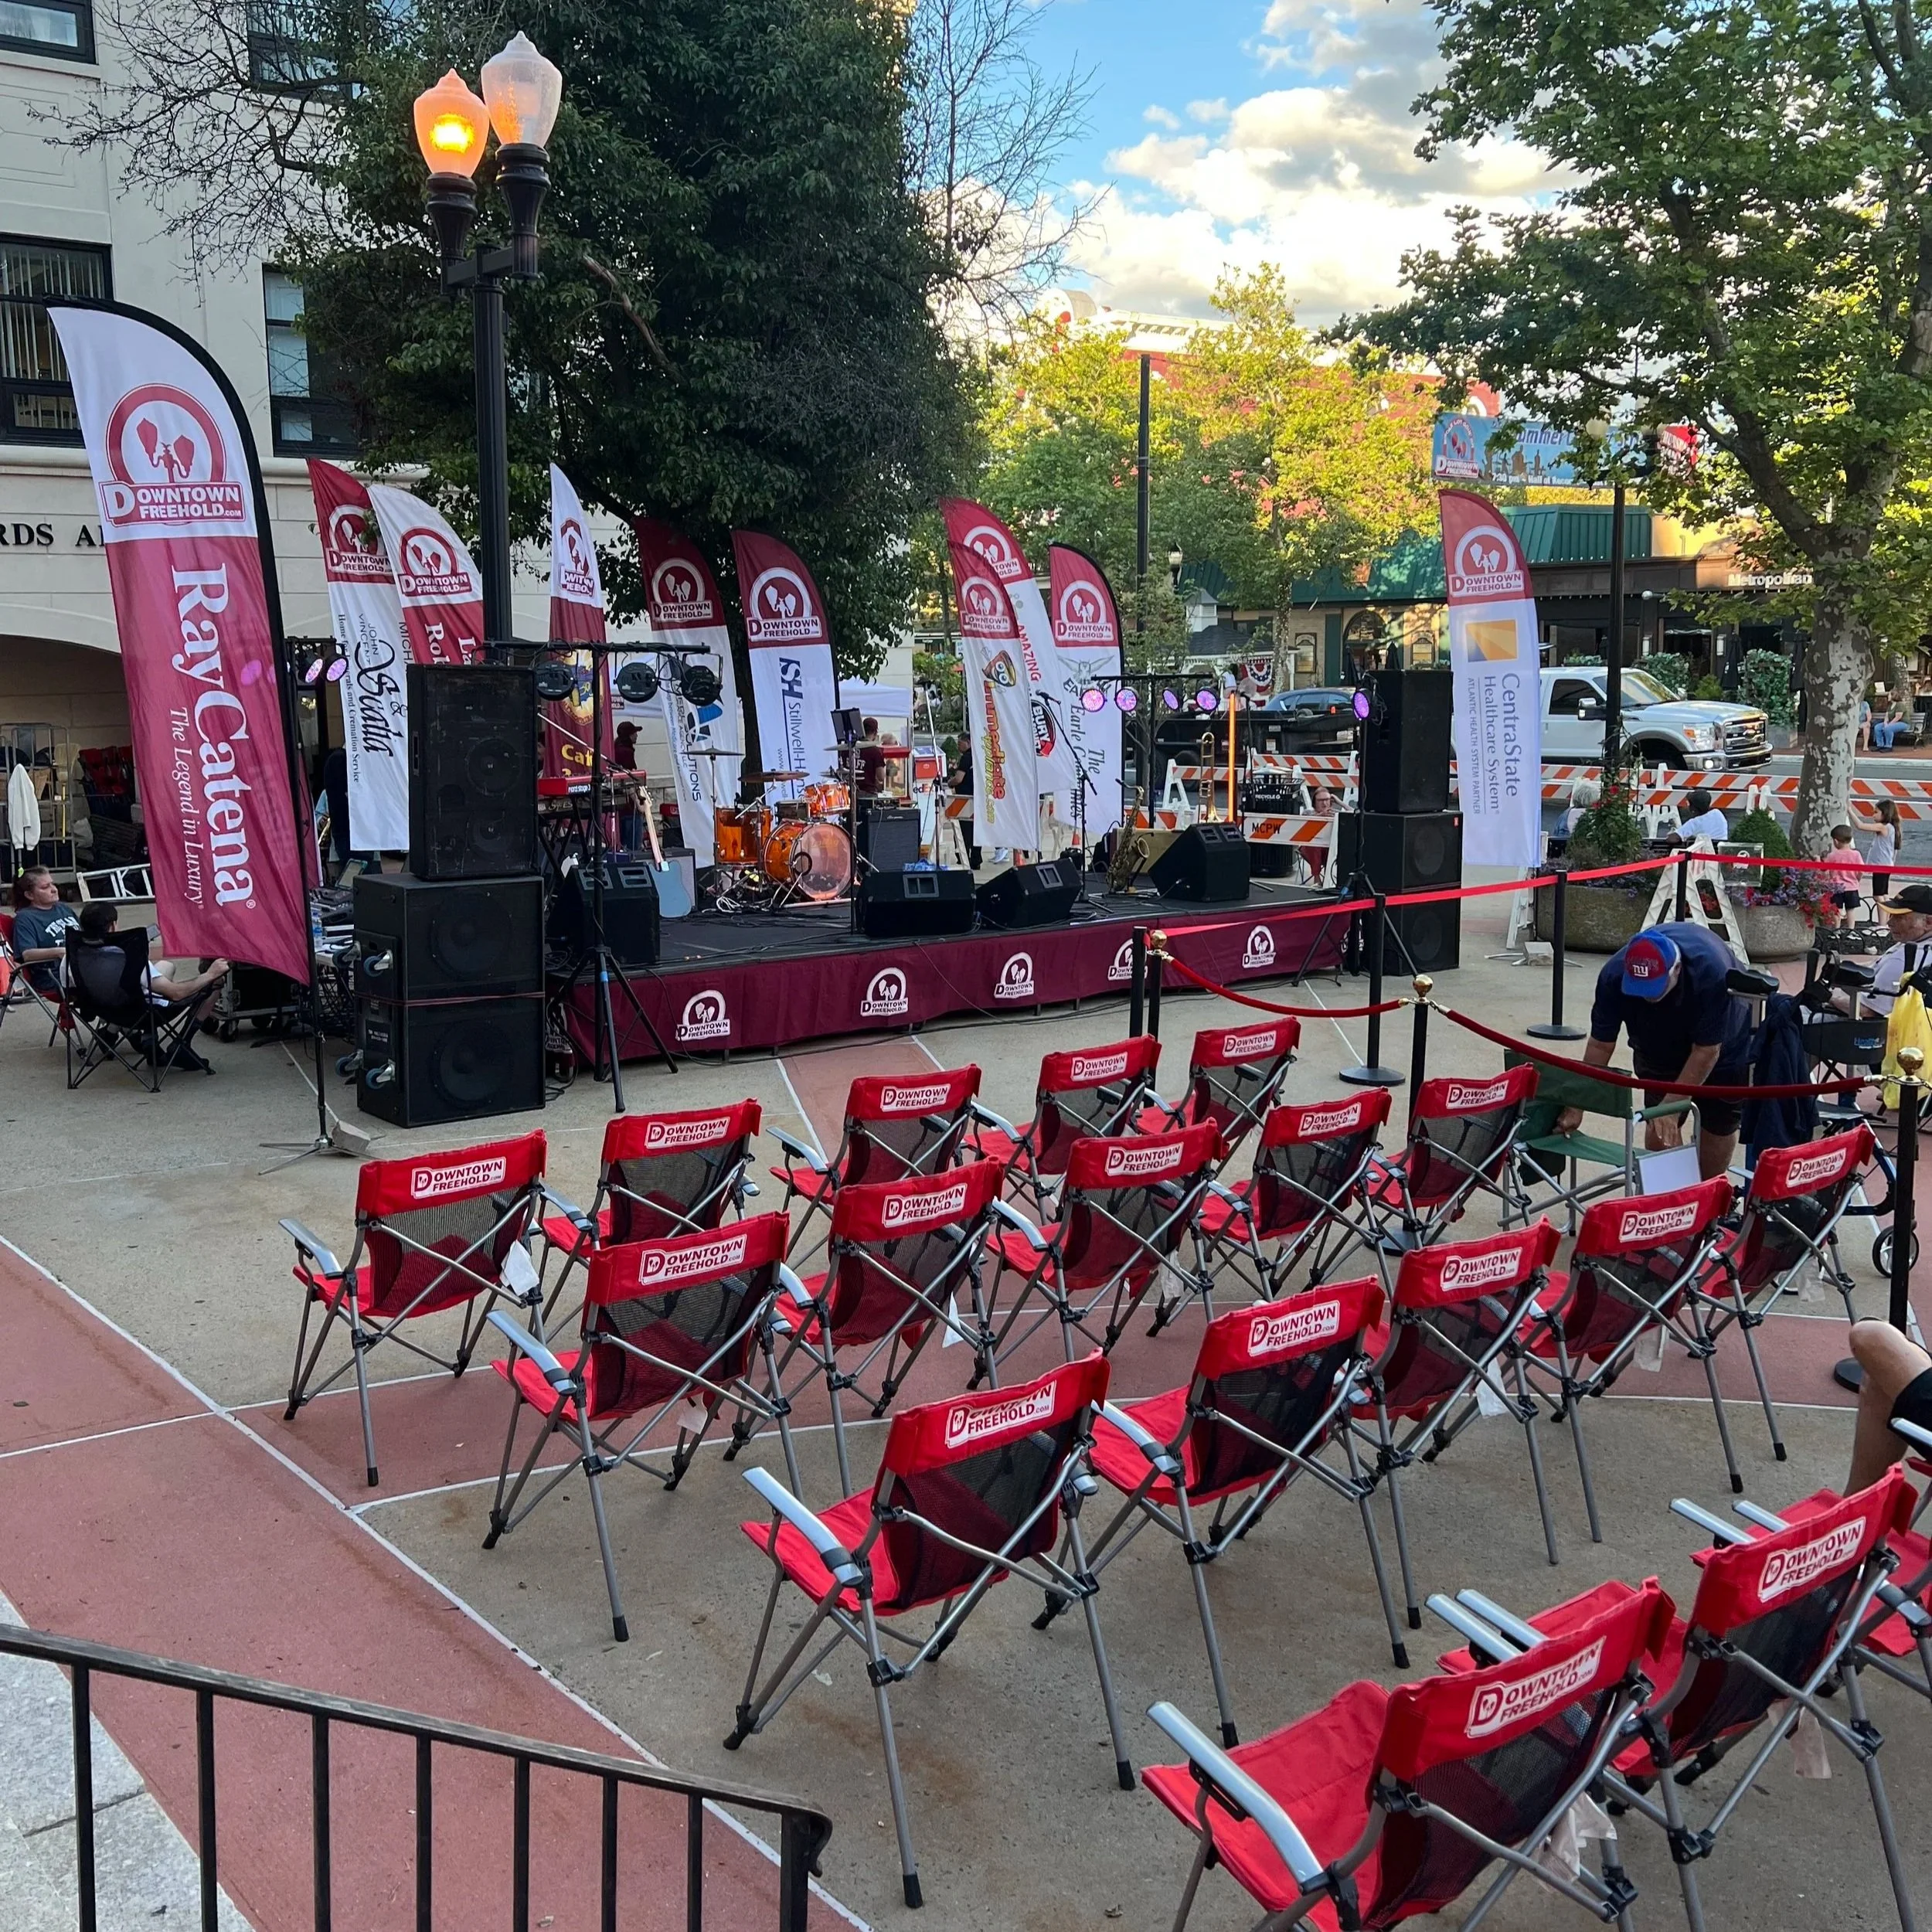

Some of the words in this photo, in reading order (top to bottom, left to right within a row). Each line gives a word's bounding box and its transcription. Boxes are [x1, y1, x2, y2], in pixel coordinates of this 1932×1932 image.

[1518, 429, 1564, 445] ummer
[104, 483, 240, 519] DOWNTOWN
[1452, 573, 1521, 592] DOWNTOWN
[368, 623, 379, 655] JOHN
[750, 619, 818, 636] DOWNTOWN
[1058, 623, 1111, 634] DOWNTOWN
[1468, 678, 1476, 715] ATLANTIC
[169, 706, 190, 741] The
[1070, 704, 1086, 741] Earle
[1484, 676, 1498, 754] Healthcare
[1502, 673, 1522, 797] CentraState
[1088, 748, 1104, 774] The
[172, 747, 193, 818] Legend
[182, 817, 197, 835] in
[1252, 821, 1281, 834] MCPW
[183, 840, 204, 904] Luxury
[679, 1022, 728, 1036] DOWNTOWN
[1225, 1034, 1274, 1052] DOWNTOWN
[1073, 1055, 1125, 1075] DOWNTOWN
[883, 1087, 948, 1105] DOWNTOWN
[648, 1120, 727, 1143] DOWNTOWN
[1109, 1145, 1181, 1168] DOWNTOWN
[414, 1161, 502, 1191] DOWNTOWN
[885, 1187, 964, 1219] DOWNTOWN
[1623, 1206, 1696, 1236] DOWNTOWN
[643, 1239, 743, 1277] DOWNTOWN
[1444, 1250, 1519, 1281] DOWNTOWN
[1251, 1306, 1335, 1347] DOWNTOWN
[1762, 1524, 1861, 1590] DOWNTOWN
[1471, 1645, 1599, 1726] DOWNTOWN
